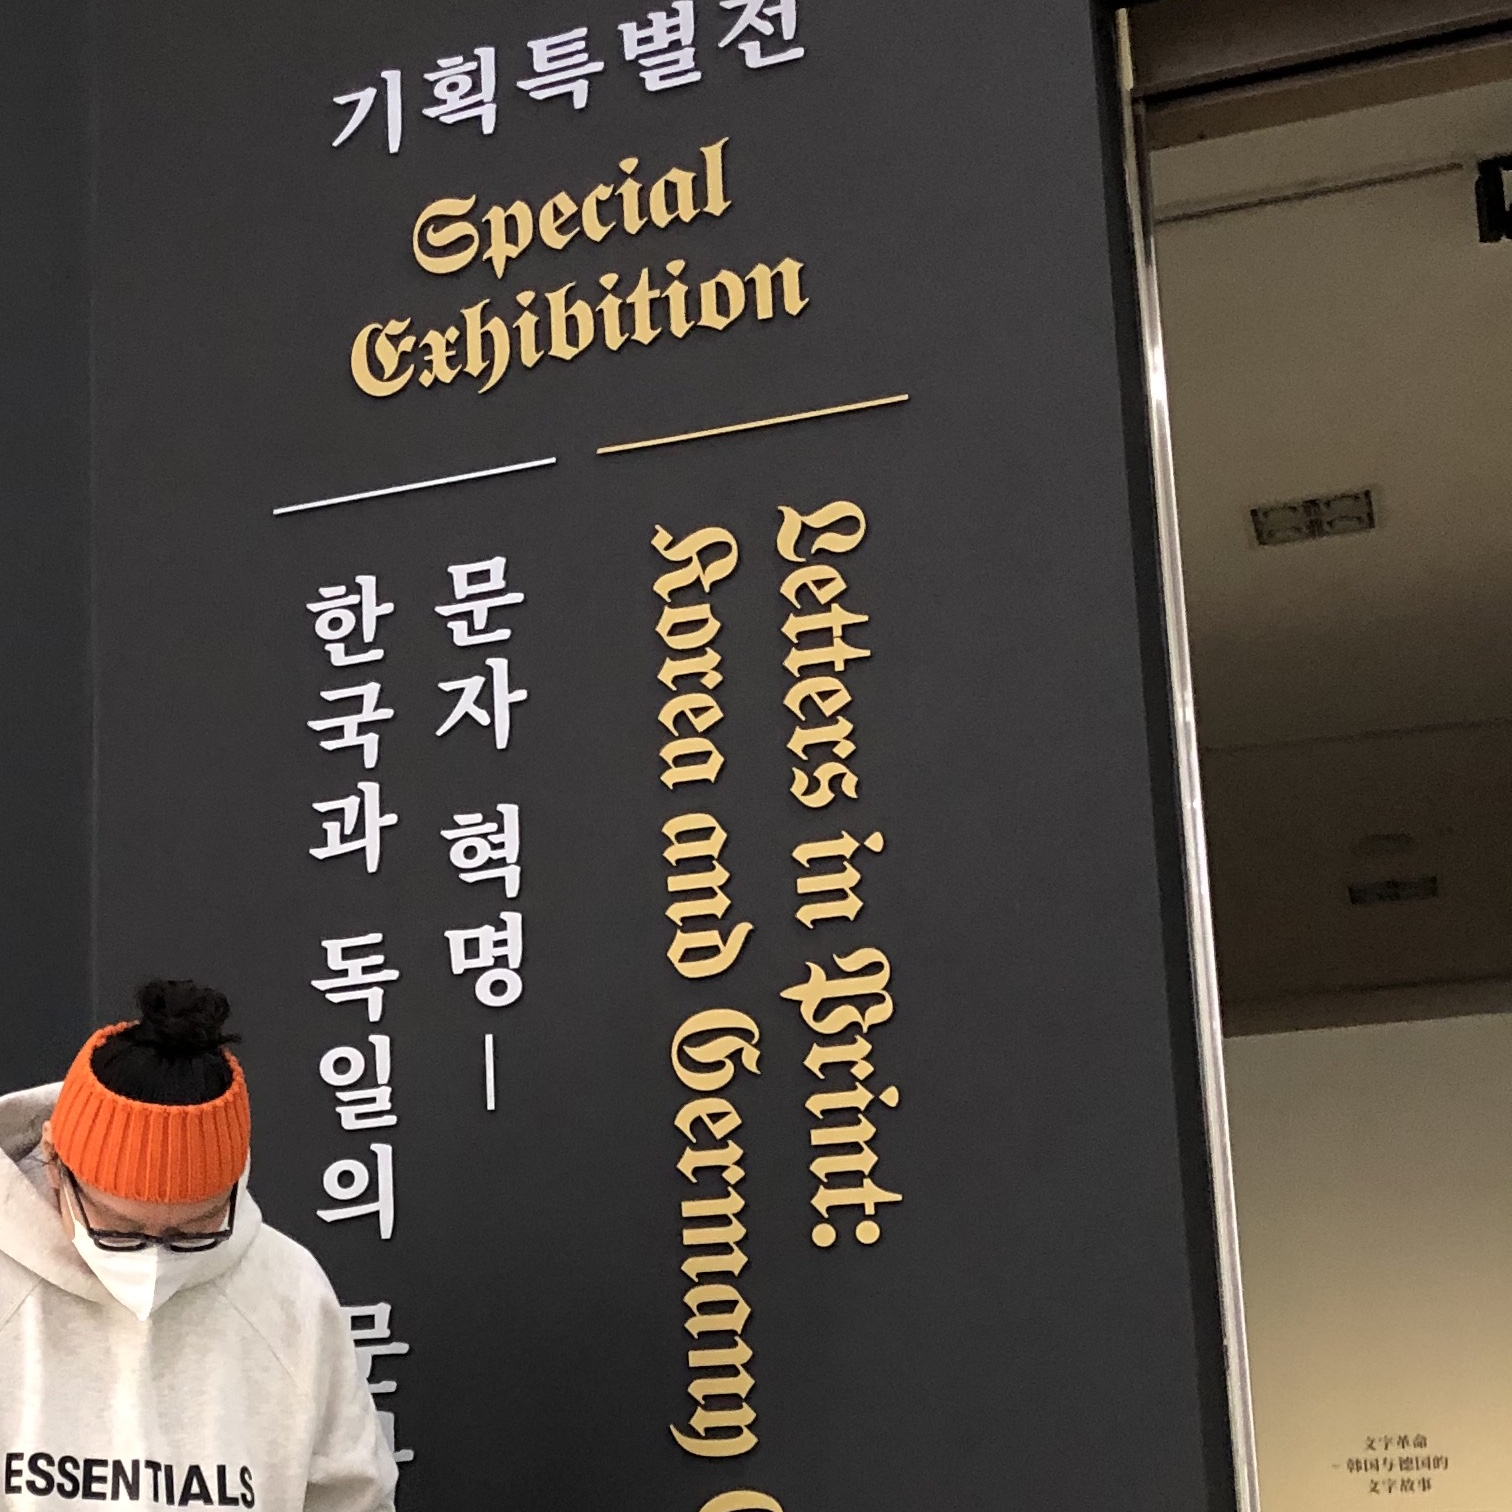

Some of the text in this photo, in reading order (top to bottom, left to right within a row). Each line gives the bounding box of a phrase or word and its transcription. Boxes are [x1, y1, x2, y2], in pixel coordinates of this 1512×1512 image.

[332, 0, 805, 153] 기획특별전
[413, 137, 732, 279] Special
[350, 257, 810, 397] Exhibition
[305, 574, 399, 874] 한국과
[433, 555, 528, 750] 문자
[650, 524, 739, 790] Korea
[661, 812, 755, 979] and
[776, 500, 903, 1248] Letters in Print:
[310, 932, 400, 1240] 독일의
[669, 1008, 762, 1457] Germany
[4, 1452, 256, 1510] ESSENTIALS
